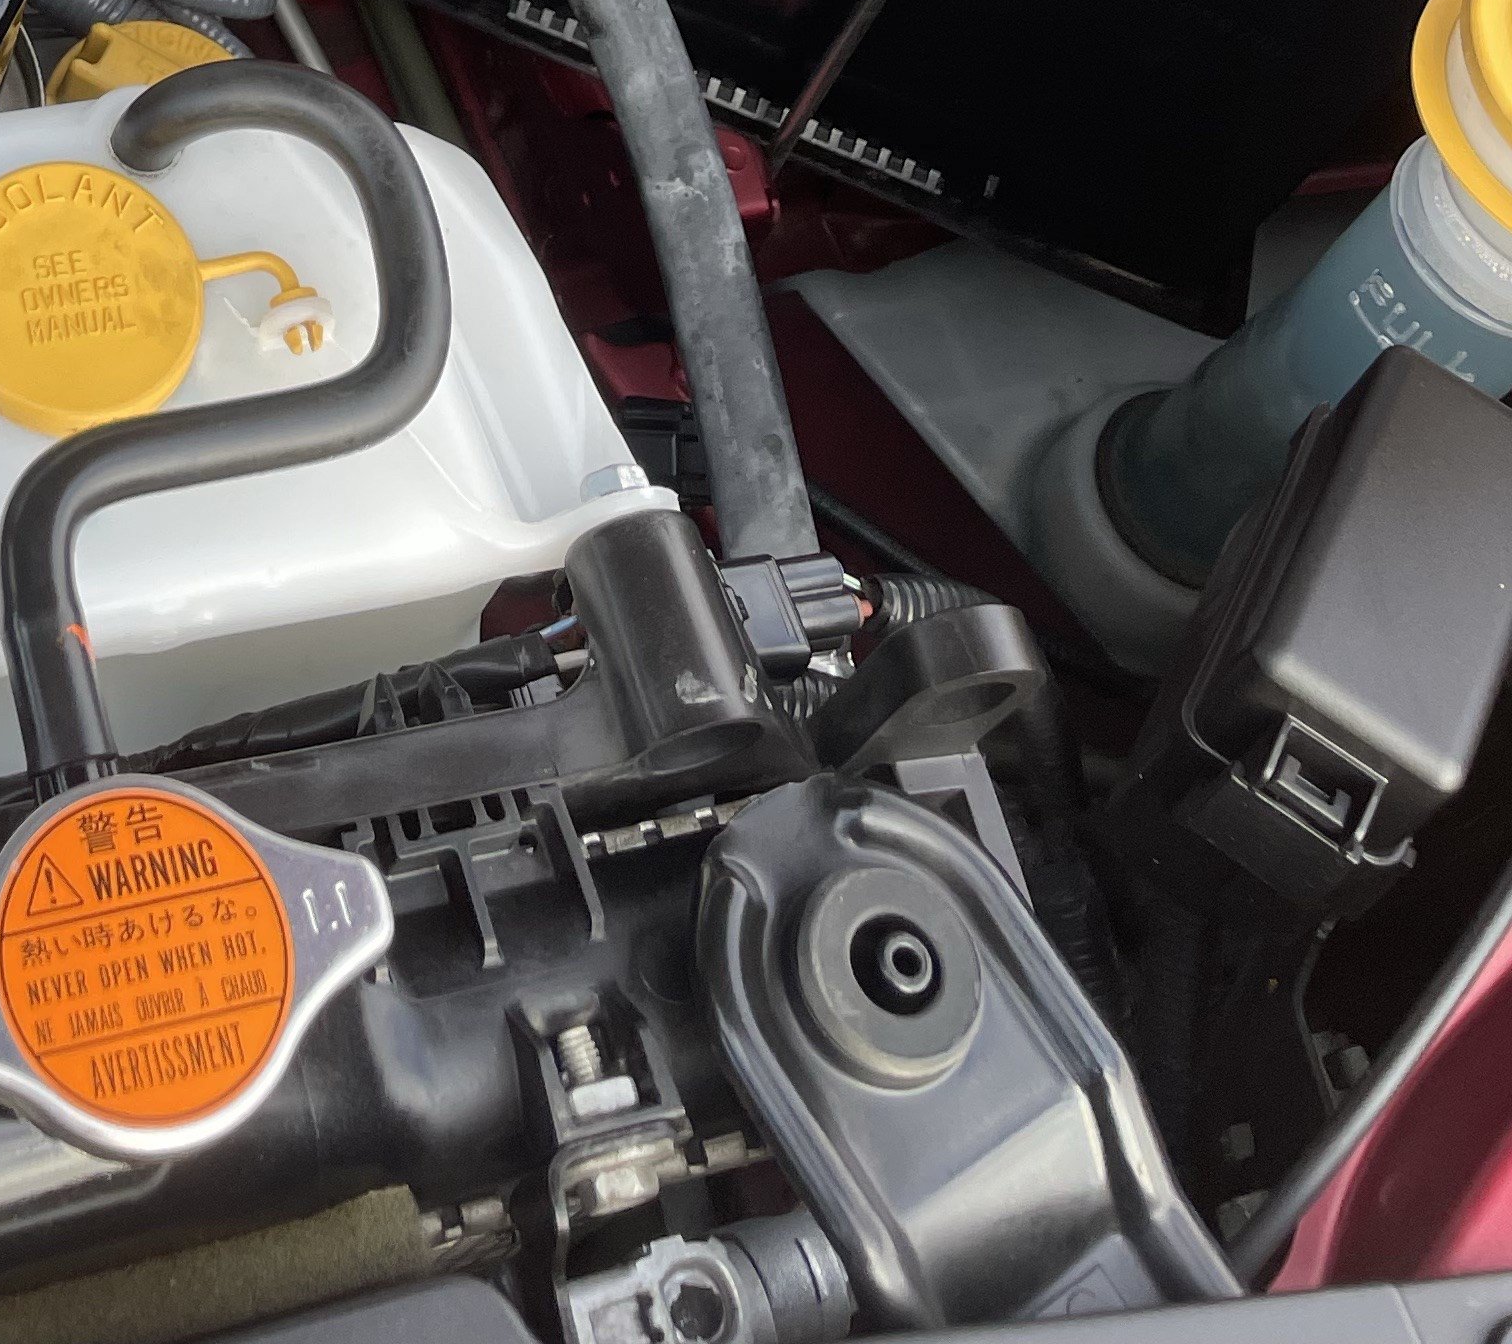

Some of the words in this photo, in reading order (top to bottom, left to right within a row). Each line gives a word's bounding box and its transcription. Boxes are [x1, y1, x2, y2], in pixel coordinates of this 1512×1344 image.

[33, 249, 88, 279] SEE
[20, 273, 130, 313] OWNERS
[25, 305, 138, 346] MANUAL
[76, 803, 164, 855] 警告
[86, 838, 221, 904] WARNING
[26, 968, 88, 1009] NEVER
[99, 957, 149, 995] OPEN
[159, 944, 214, 983] WHEN
[67, 1002, 125, 1034] JAMAIS
[135, 988, 188, 1023] OUVRIR
[87, 1021, 249, 1101] AVERTISSMENT
